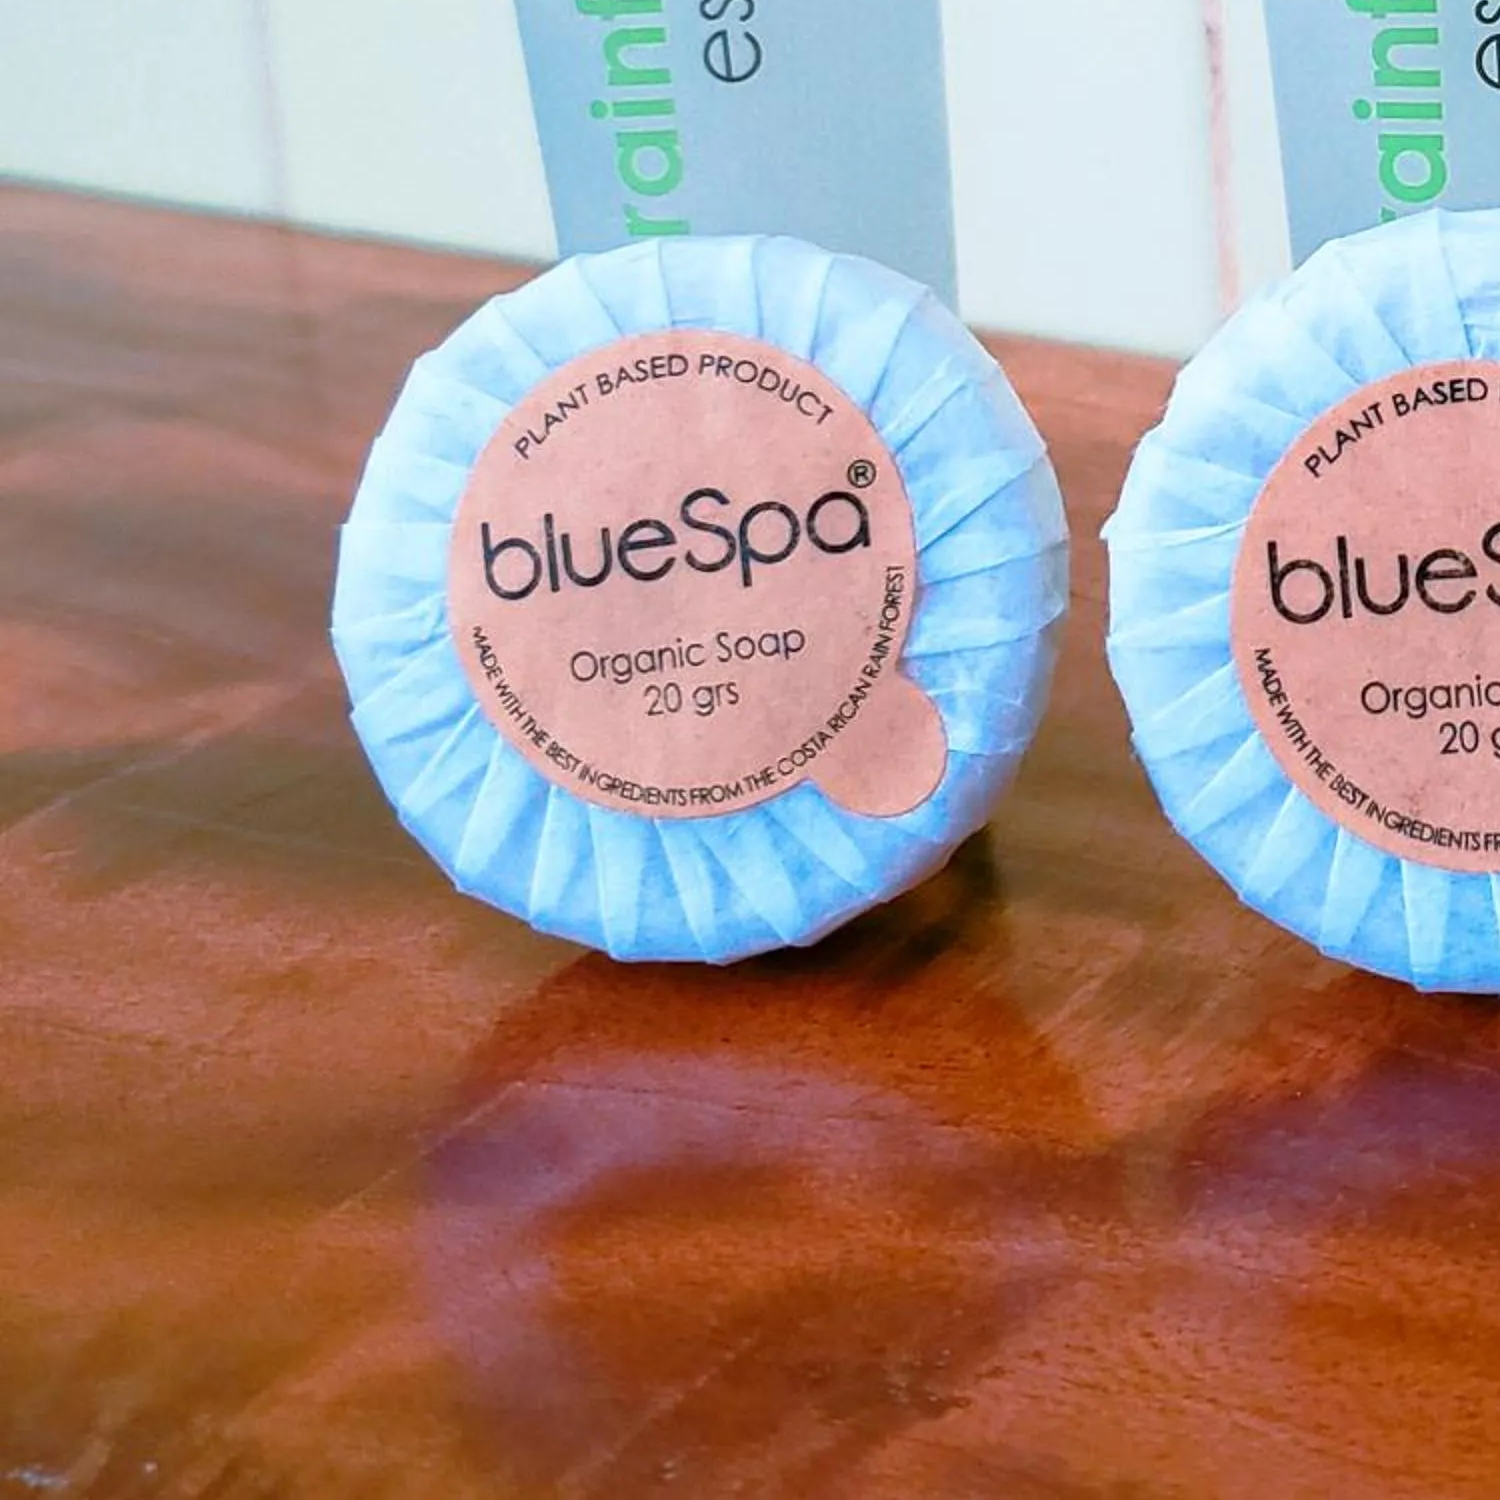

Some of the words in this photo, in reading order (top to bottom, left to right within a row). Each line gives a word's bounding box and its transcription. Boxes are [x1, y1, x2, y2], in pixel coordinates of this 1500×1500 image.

[514, 385, 590, 460] PLANT
[597, 354, 689, 395] BASED
[699, 355, 834, 426] PRODUCT
[1304, 403, 1386, 479] PLANT
[1393, 377, 1489, 418] BASED
[571, 637, 705, 685] Organic
[716, 629, 806, 662] Soap
[643, 682, 683, 717] 20
[691, 681, 740, 717] grs
[472, 626, 503, 682] MADE
[495, 678, 528, 722] WITH
[520, 715, 549, 749] THE
[545, 741, 582, 773] BEST
[690, 782, 744, 805] FROM
[743, 766, 778, 792] THE
[777, 731, 833, 776] COSTA
[827, 677, 873, 733] RICAN
[1254, 648, 1288, 707] MADE
[1276, 703, 1312, 753] WITH
[1304, 745, 1336, 782] THE
[1329, 773, 1370, 810] BEST
[1439, 720, 1480, 755] 20
